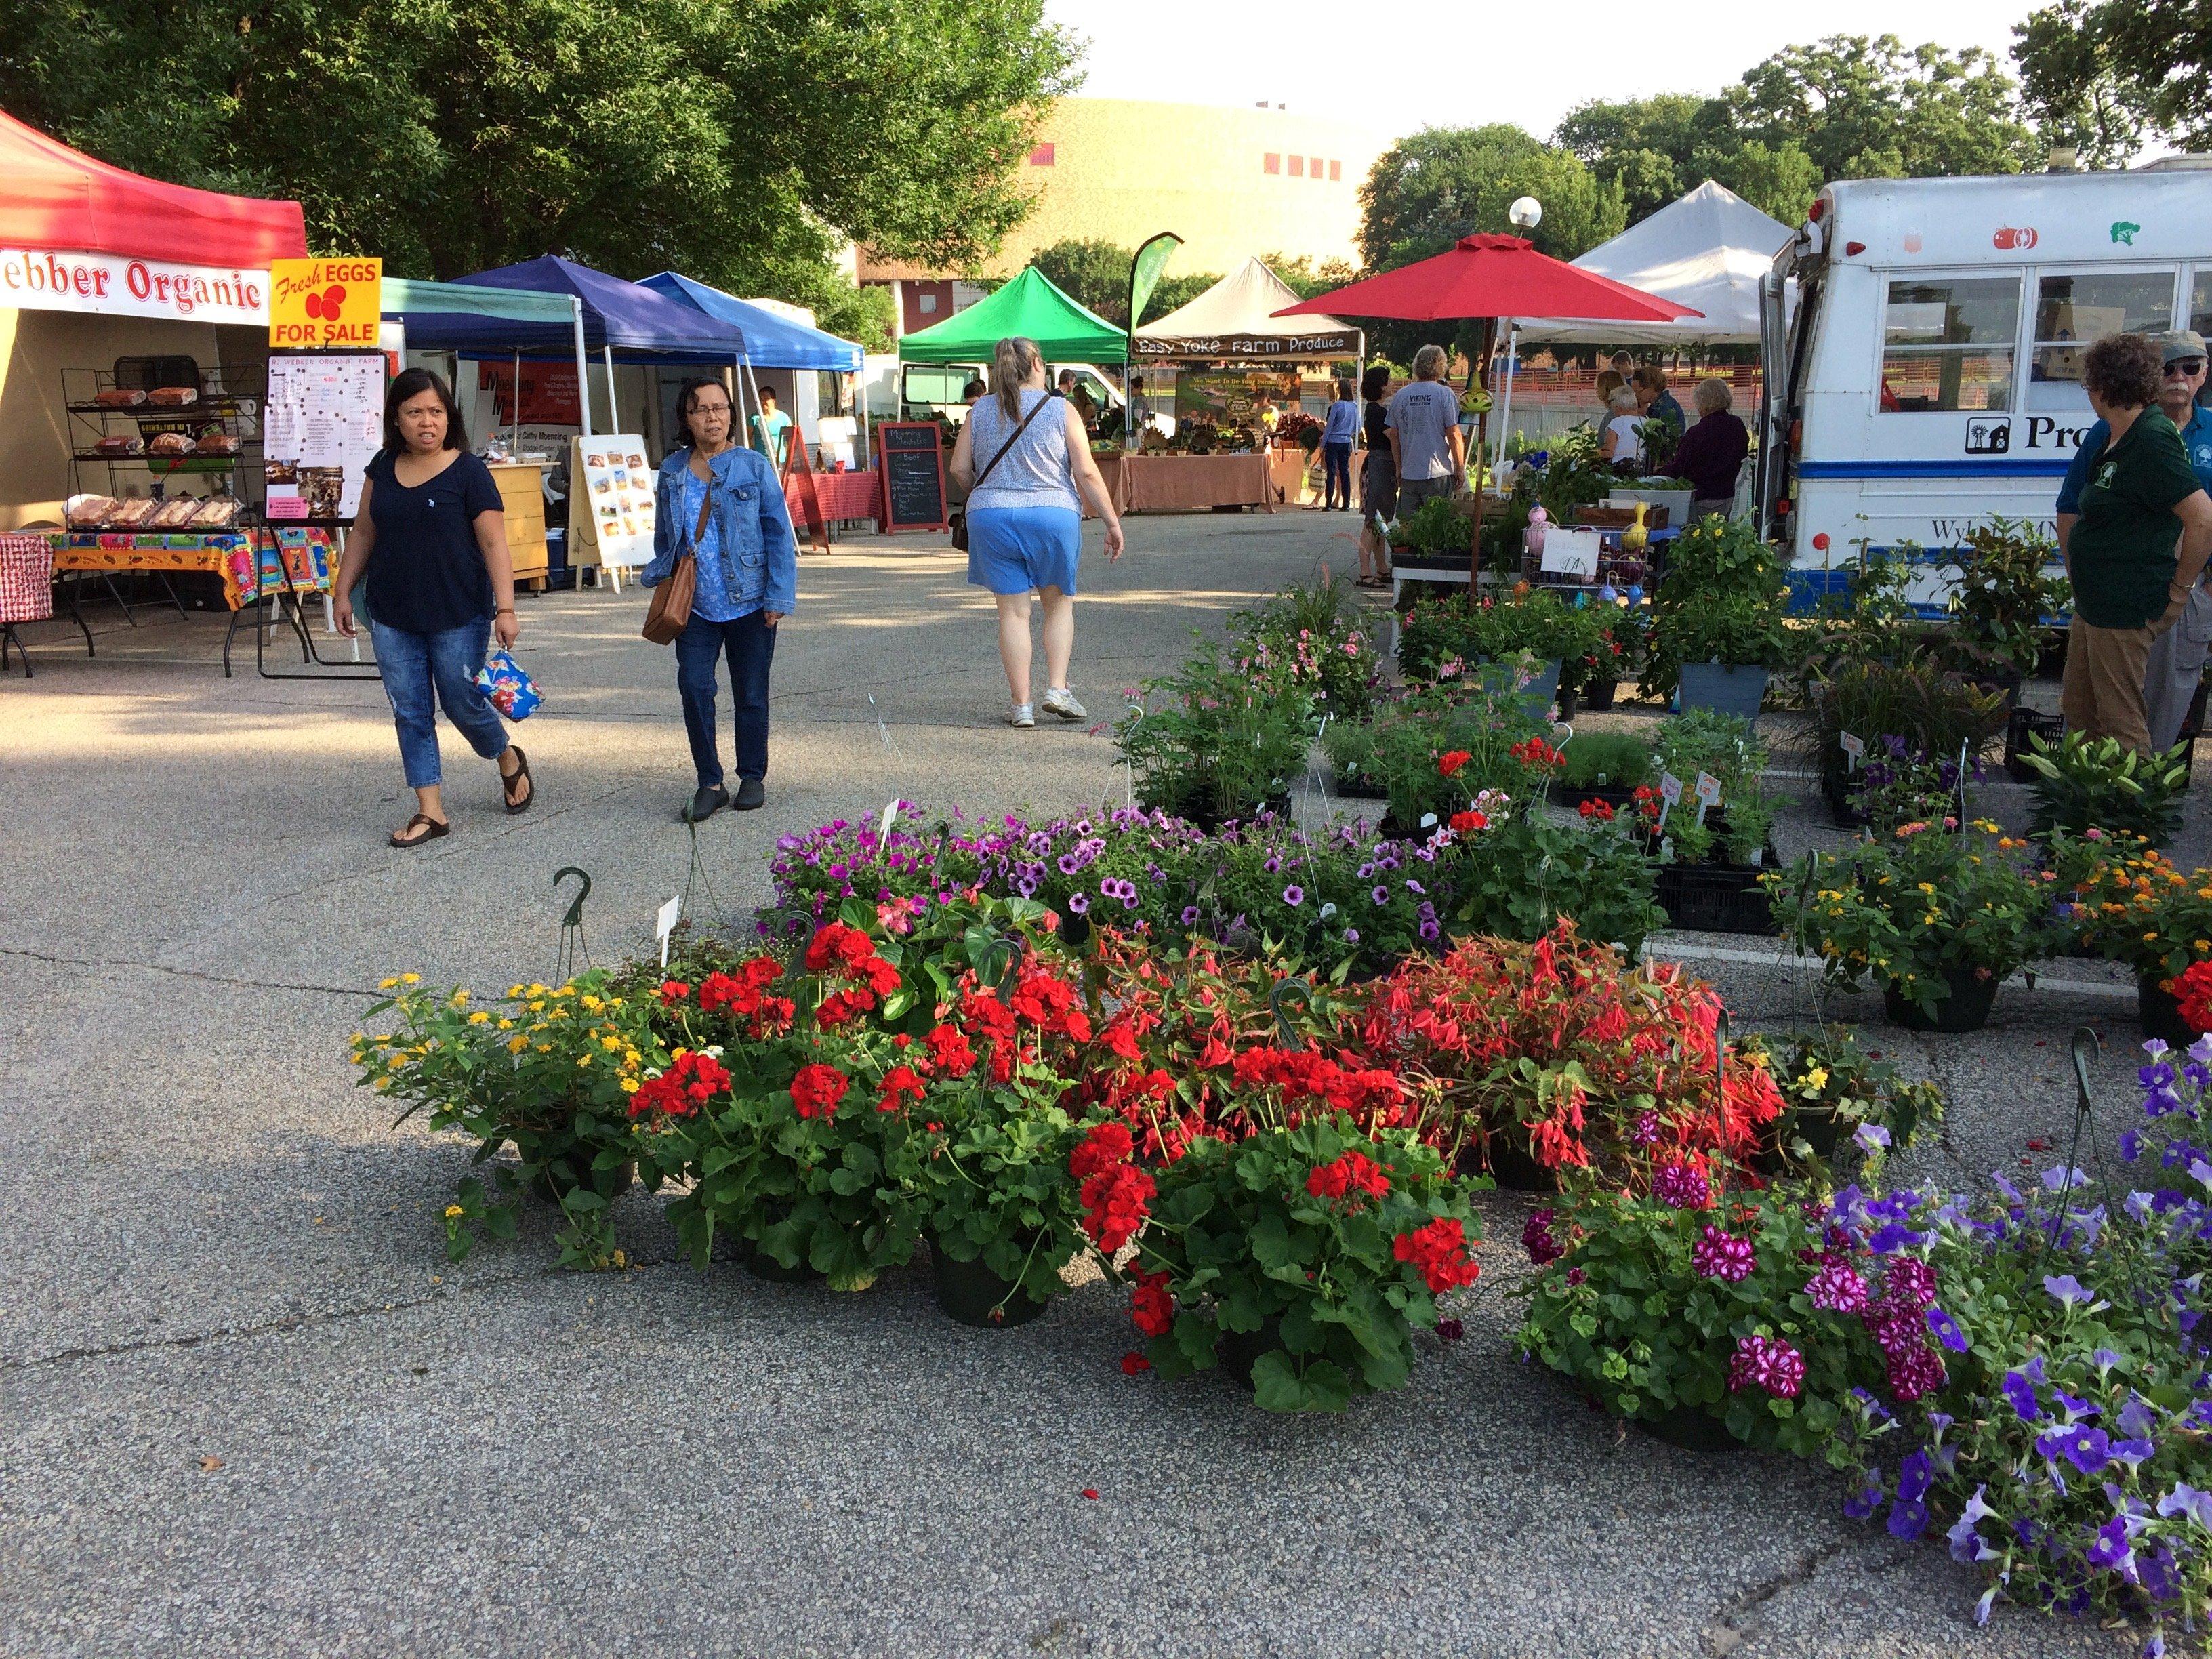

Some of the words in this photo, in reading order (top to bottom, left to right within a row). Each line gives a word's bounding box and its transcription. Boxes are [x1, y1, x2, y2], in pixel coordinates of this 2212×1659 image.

[1, 250, 110, 298] ebber
[125, 260, 262, 314] Organic
[275, 263, 323, 305] Fresh
[325, 264, 376, 282] EGGS
[276, 325, 317, 342] FOR
[323, 323, 373, 342] SALE
[1139, 340, 1174, 354] Easy
[1181, 340, 1221, 353] Yoke
[1232, 340, 1280, 353] Farm
[1289, 337, 1345, 352] Produce
[522, 431, 537, 441] Cathy
[538, 432, 567, 443] Moenning
